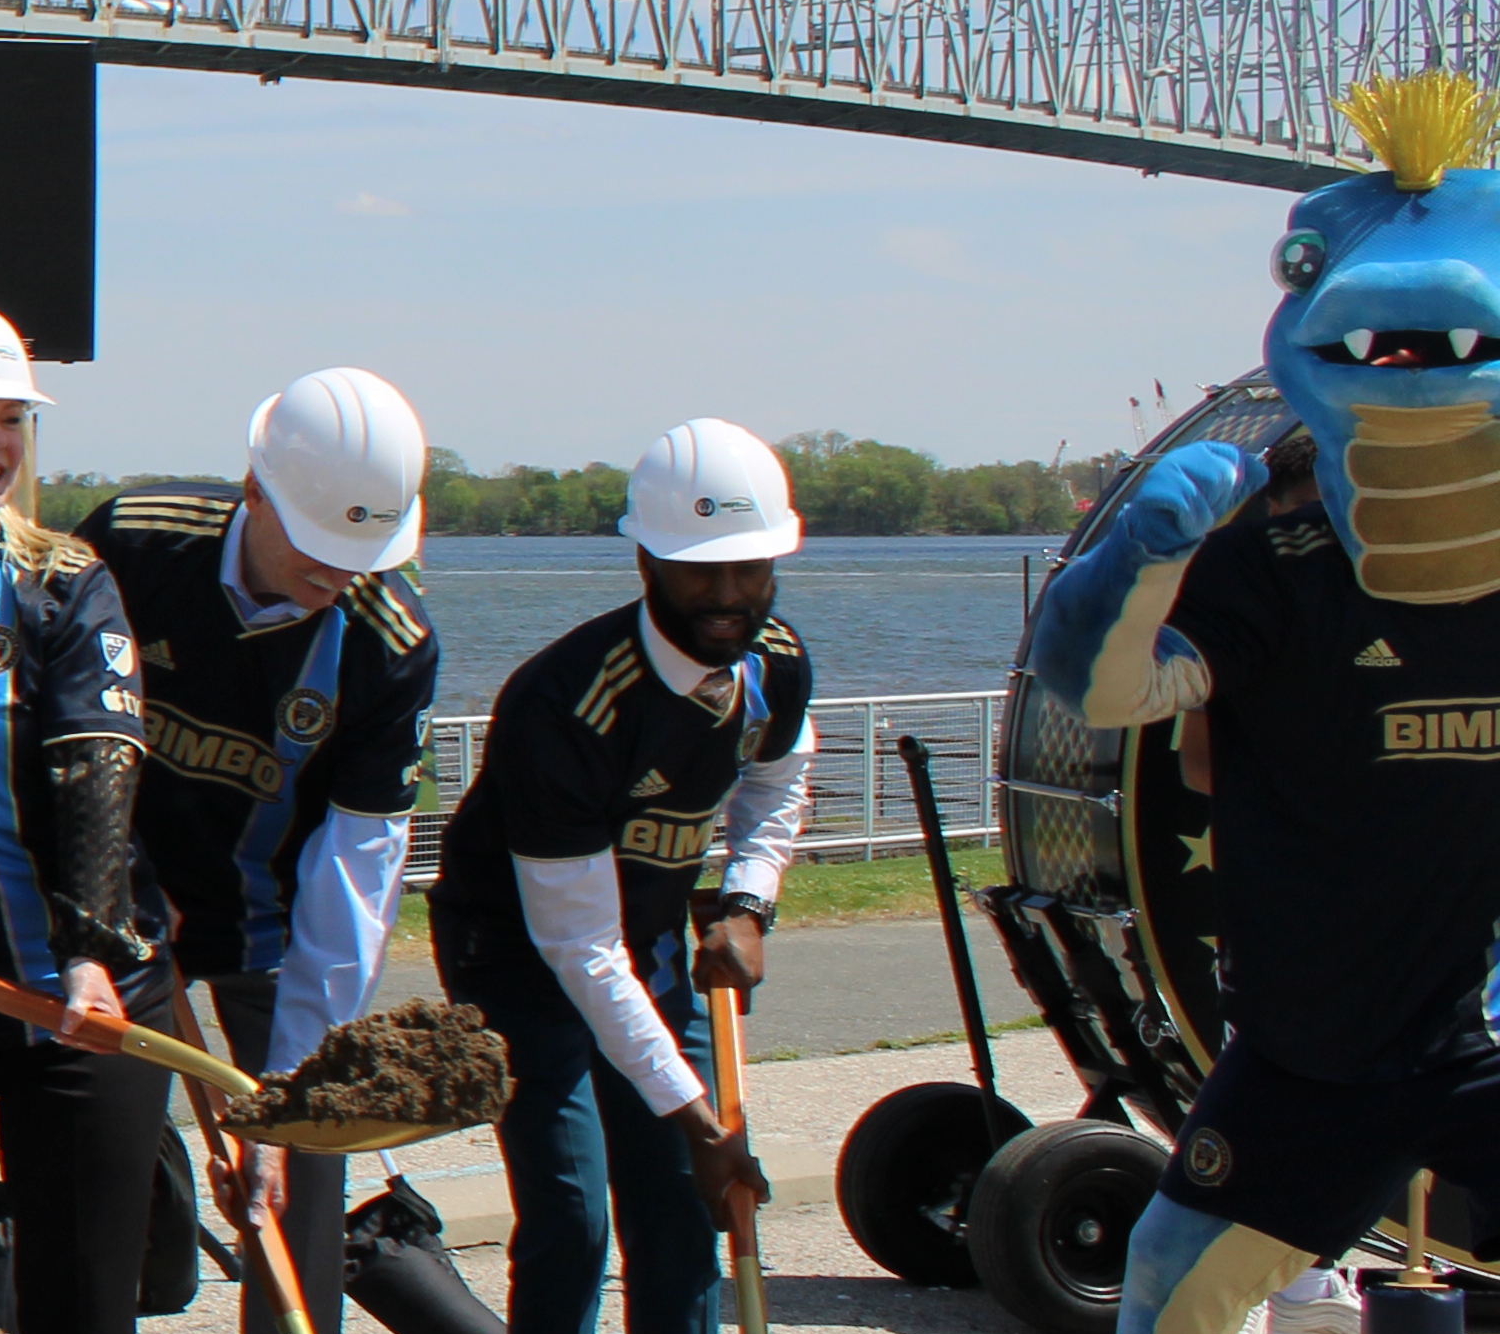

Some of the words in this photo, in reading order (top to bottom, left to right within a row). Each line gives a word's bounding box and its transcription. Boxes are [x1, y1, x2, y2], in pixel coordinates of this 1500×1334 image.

[1353, 656, 1402, 667] adidas
[1384, 708, 1500, 749] BIM
[144, 708, 284, 794] BIMBO
